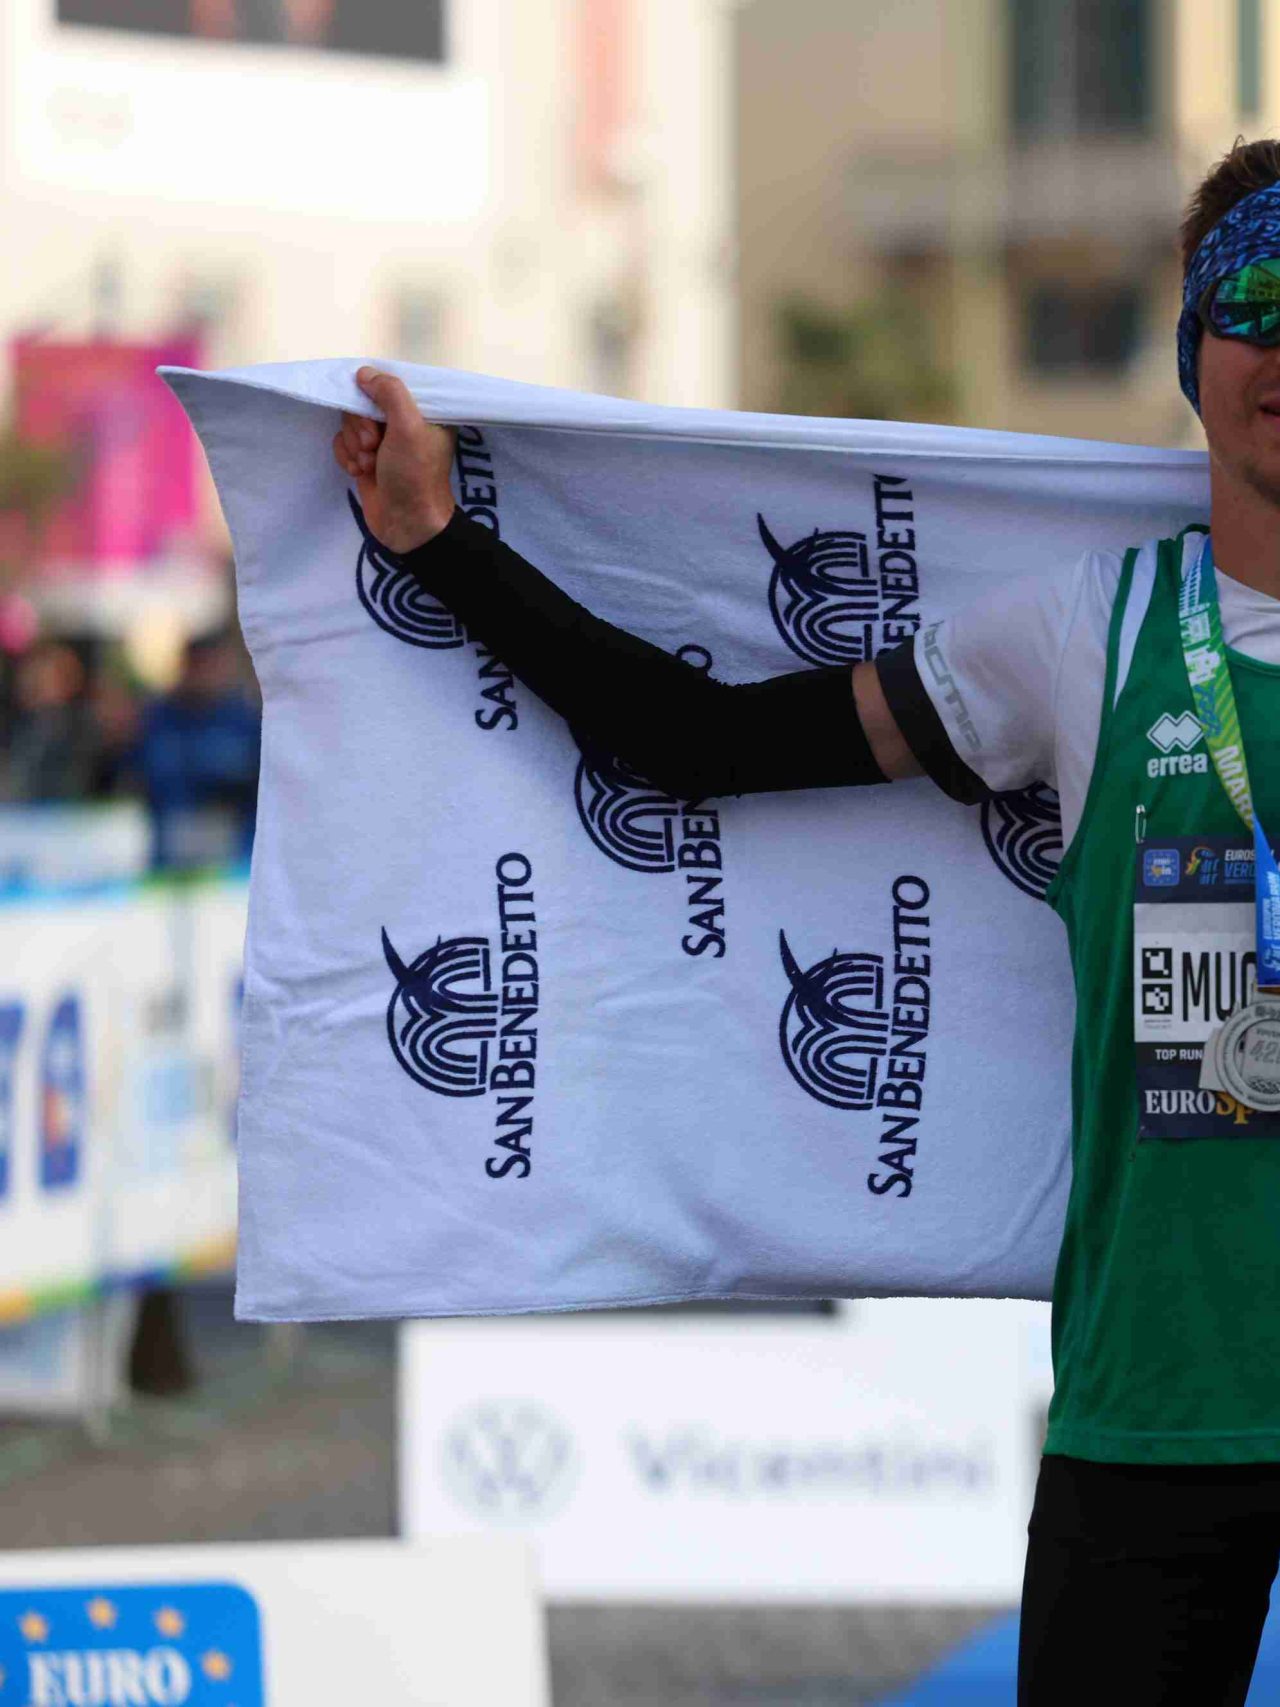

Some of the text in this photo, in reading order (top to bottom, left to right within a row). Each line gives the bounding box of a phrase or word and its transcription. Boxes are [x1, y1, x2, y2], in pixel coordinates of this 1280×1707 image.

[1147, 753, 1208, 778] errea
[682, 874, 726, 959] SAN
[485, 853, 539, 1179] SAN BENEDETTO
[867, 875, 930, 1198] SAN BENEDETTO
[1155, 1049, 1177, 1060] TOP
[27, 1647, 193, 1707] EURO
